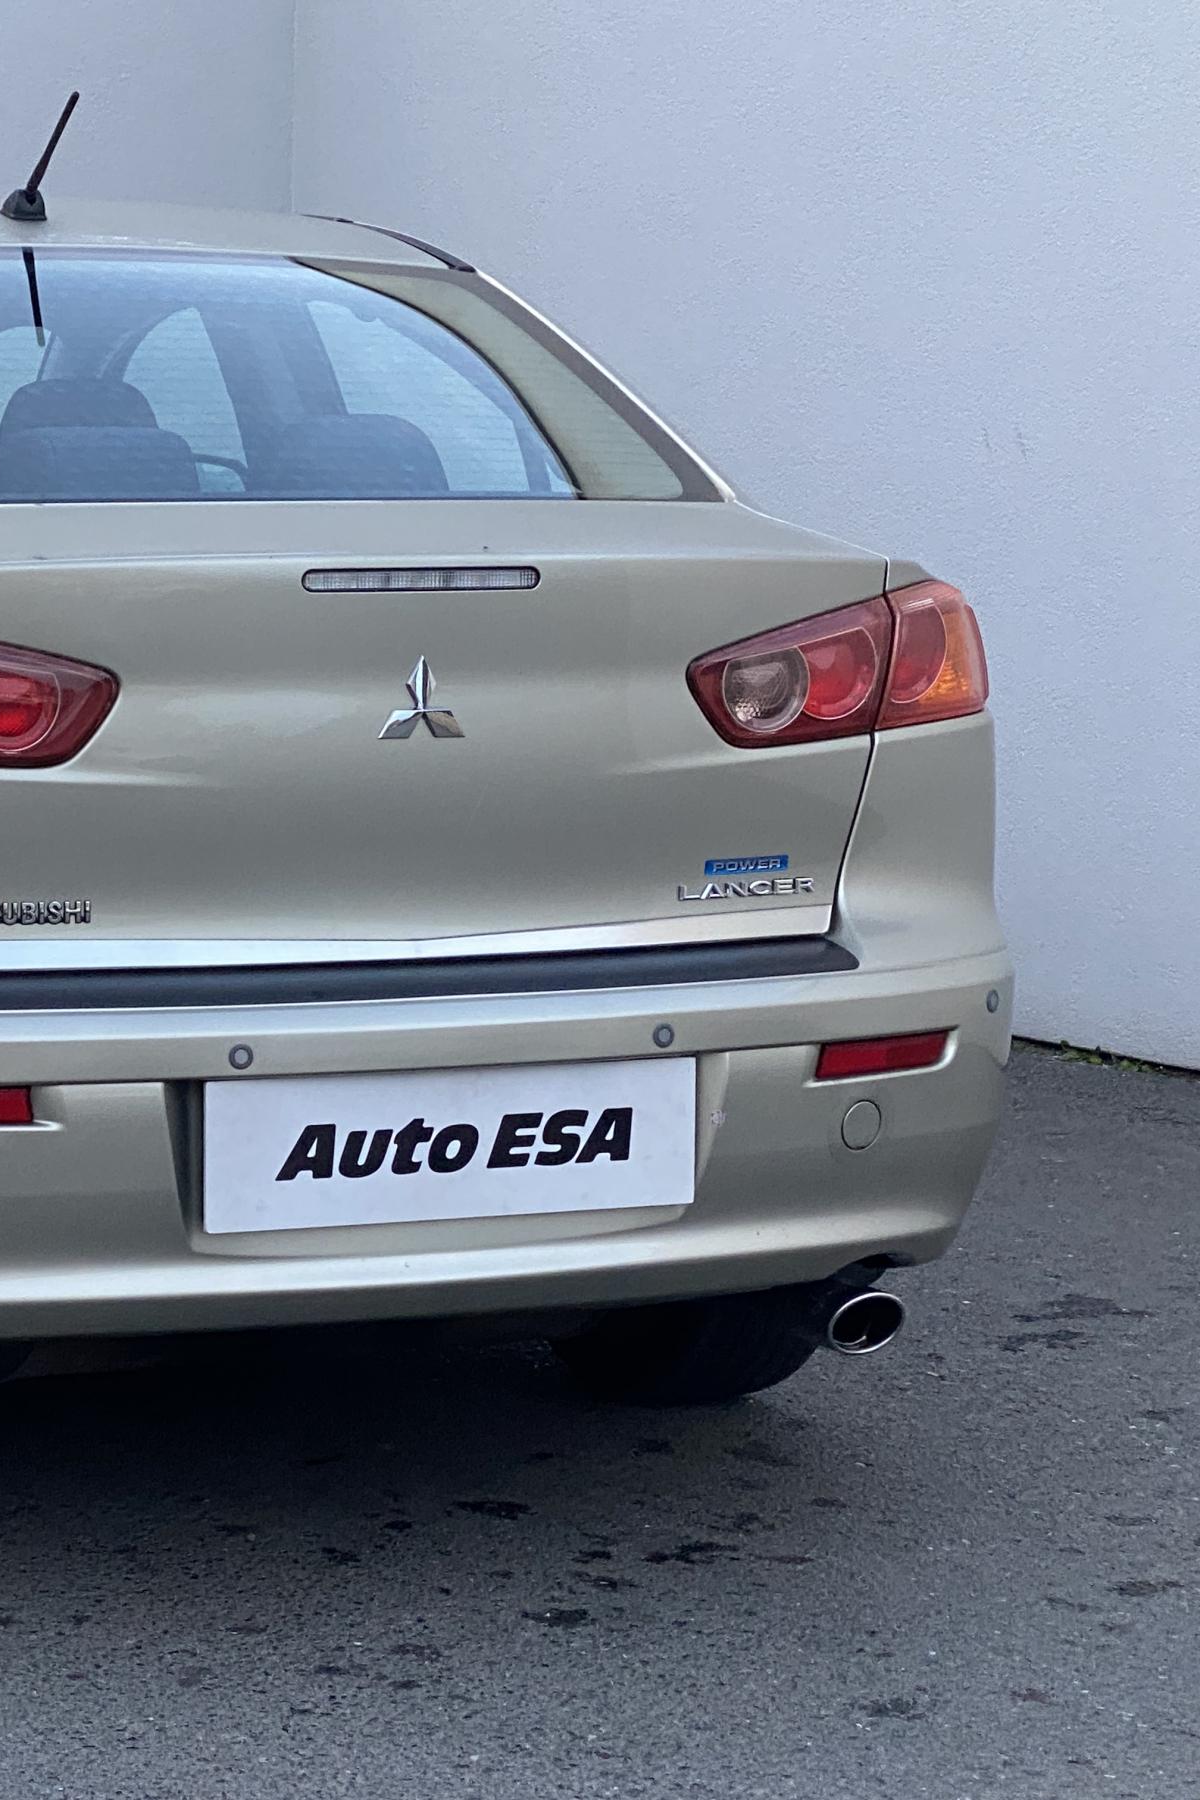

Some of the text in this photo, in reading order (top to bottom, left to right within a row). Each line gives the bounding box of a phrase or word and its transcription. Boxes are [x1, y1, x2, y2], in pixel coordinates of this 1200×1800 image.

[712, 857, 782, 873] POWER
[677, 876, 816, 901] LANCER
[274, 1106, 634, 1182] Auto ESA
